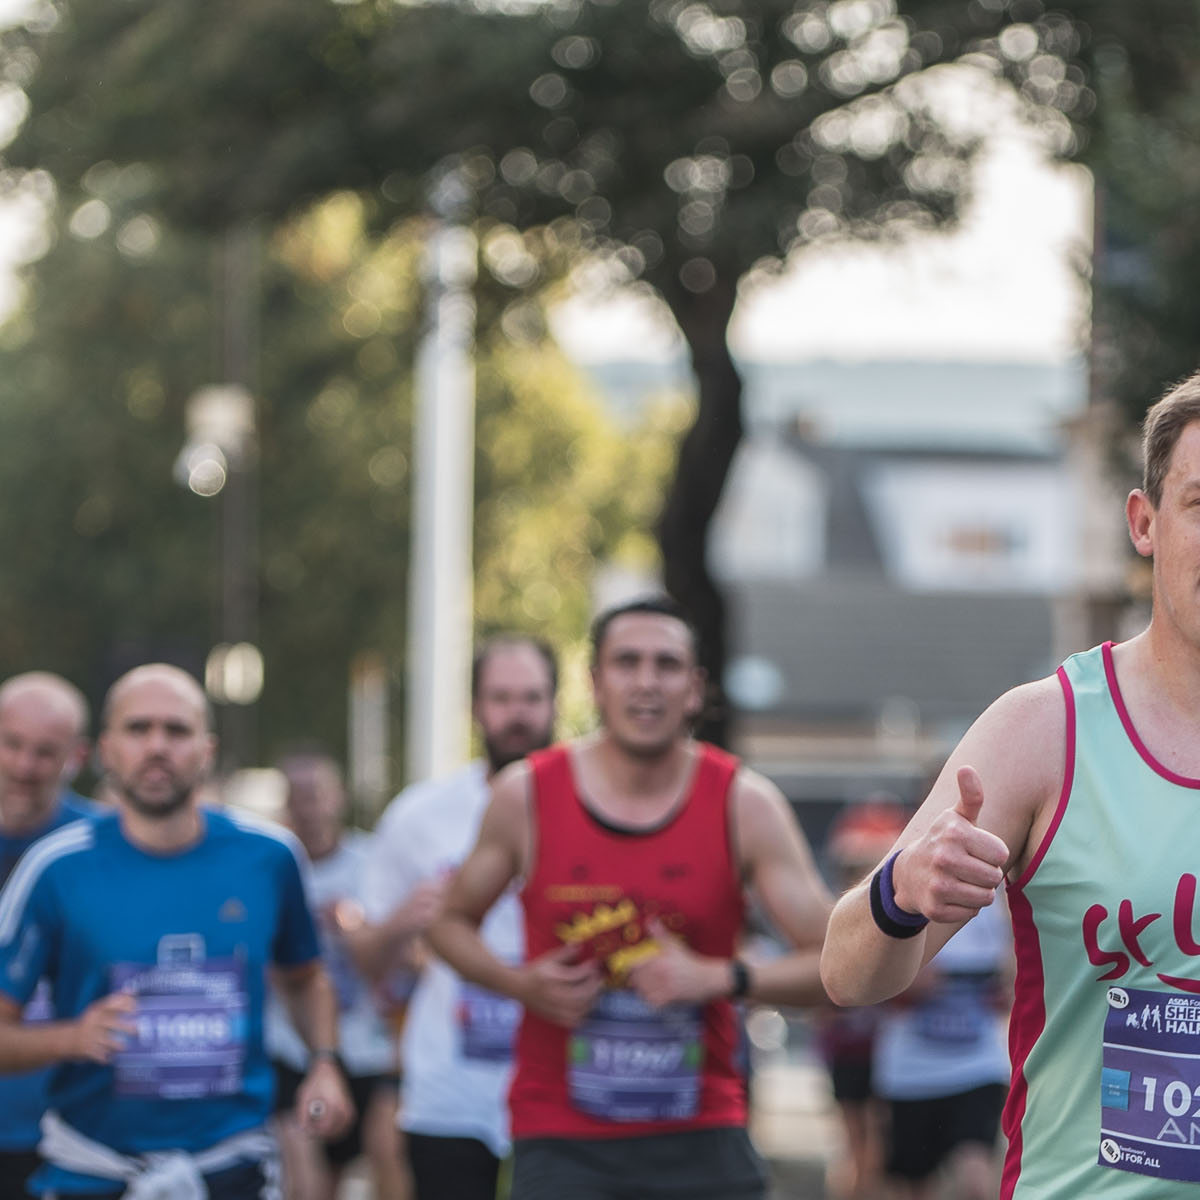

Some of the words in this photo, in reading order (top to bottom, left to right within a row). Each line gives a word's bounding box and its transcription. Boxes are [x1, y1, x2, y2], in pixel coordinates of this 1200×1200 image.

[1082, 899, 1162, 982] St
[1167, 998, 1189, 1006] ASDA
[1125, 1154, 1143, 1165] FOR
[1144, 1157, 1161, 1168] ALL
